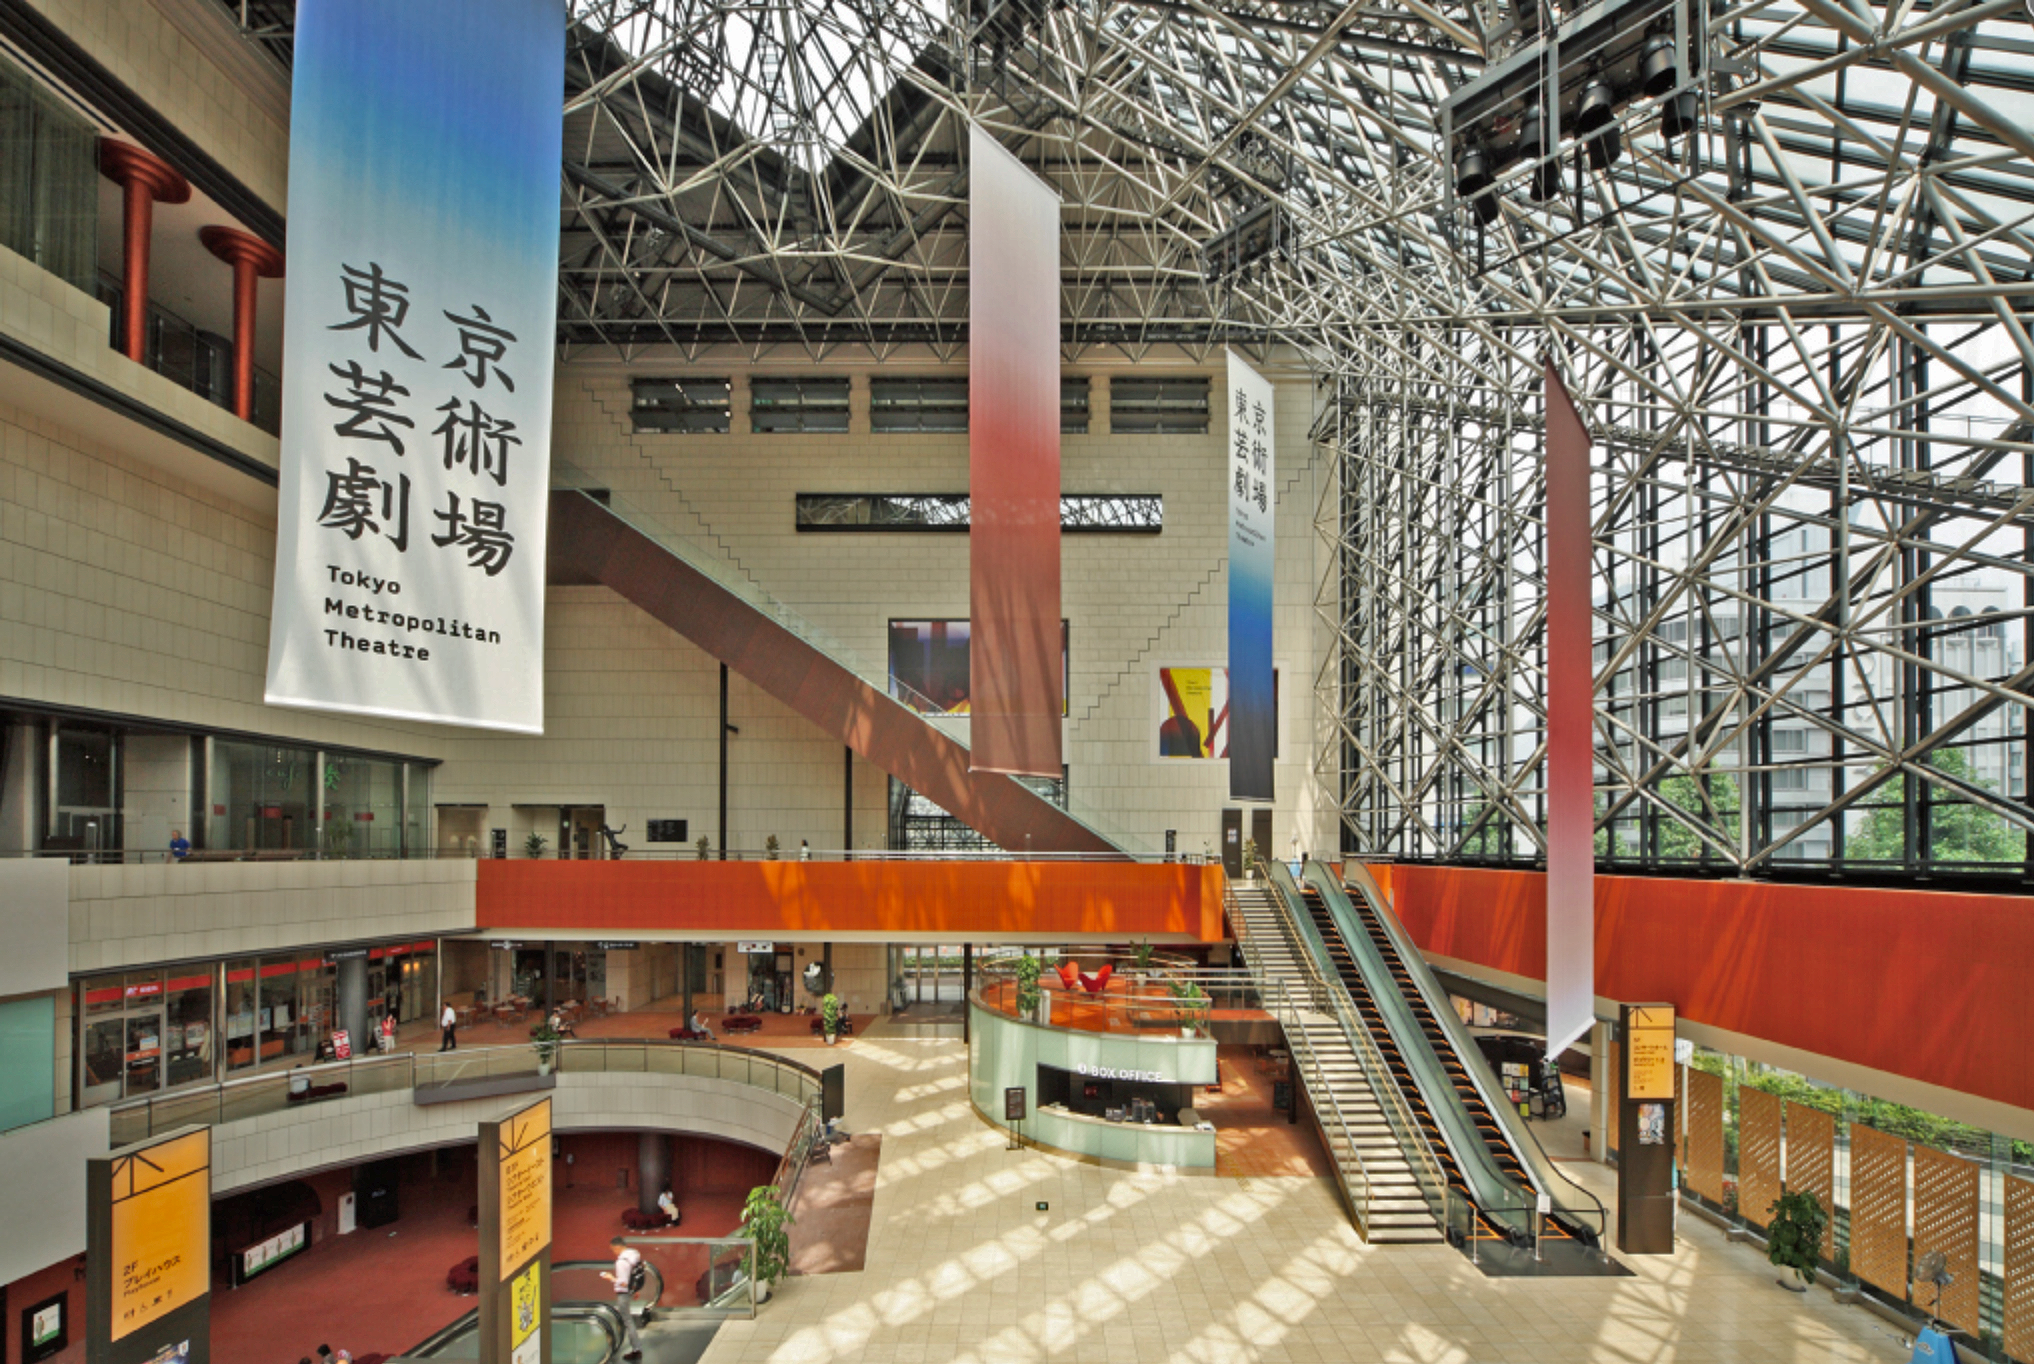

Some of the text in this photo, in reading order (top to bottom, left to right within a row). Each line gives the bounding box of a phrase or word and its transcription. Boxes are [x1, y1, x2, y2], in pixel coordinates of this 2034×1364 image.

[326, 262, 518, 392] 東京
[323, 360, 522, 486] 芸術
[1234, 388, 1267, 436] 東京
[317, 457, 515, 577] 劇場
[327, 564, 401, 595] Tokyo
[324, 597, 501, 645] Metropolitan
[324, 629, 430, 661] Theatre
[1091, 1065, 1163, 1083] BOX OFFICE
[123, 1260, 138, 1277] 2F
